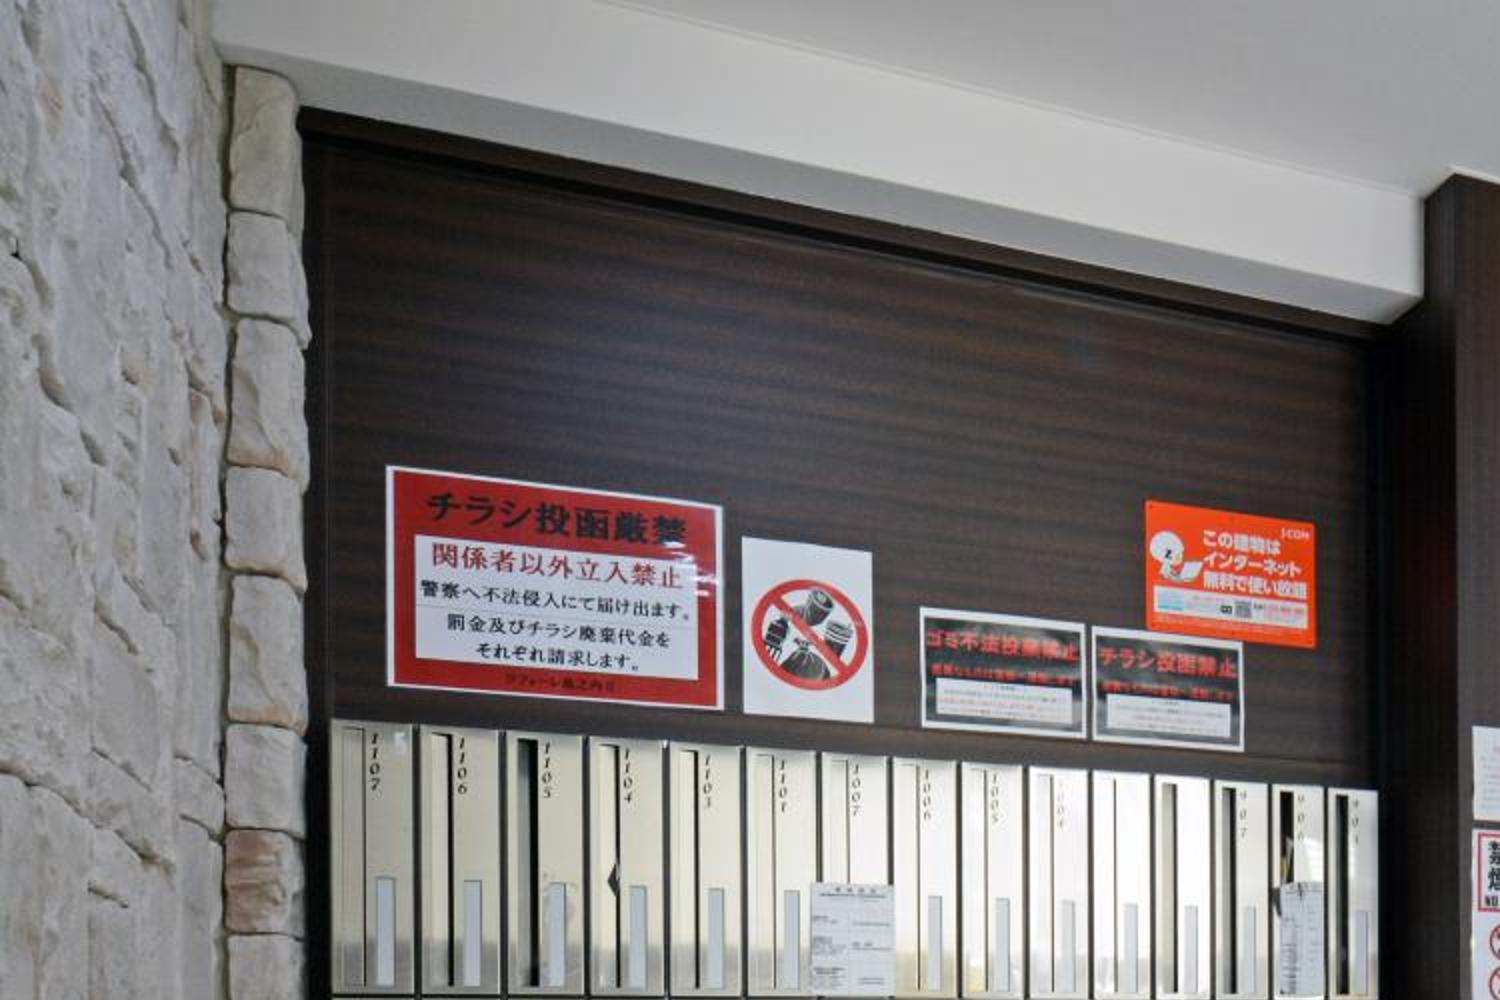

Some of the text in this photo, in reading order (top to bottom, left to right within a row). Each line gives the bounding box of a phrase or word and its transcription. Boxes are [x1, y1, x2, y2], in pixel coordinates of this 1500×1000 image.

[427, 490, 688, 546] チラシ投函厳禁
[1202, 529, 1281, 556] この建物は
[431, 543, 685, 589] 関係者以外立入禁止
[1202, 551, 1303, 577] インターネット
[420, 580, 691, 622] 警察へ不法侵入にて届け出ます。
[1202, 572, 1308, 600] 無料で使い放題
[447, 614, 671, 649] 罰金及びチラシ廃棄代金を
[475, 643, 639, 672] それぞれ請求します。
[1099, 648, 1237, 680] チラシ投函禁止
[370, 732, 381, 791] 1107
[457, 737, 468, 794] 1106
[541, 741, 552, 799] 1105
[623, 747, 633, 804] 1104
[851, 763, 861, 818] 1007
[1485, 896, 1499, 908] NO
